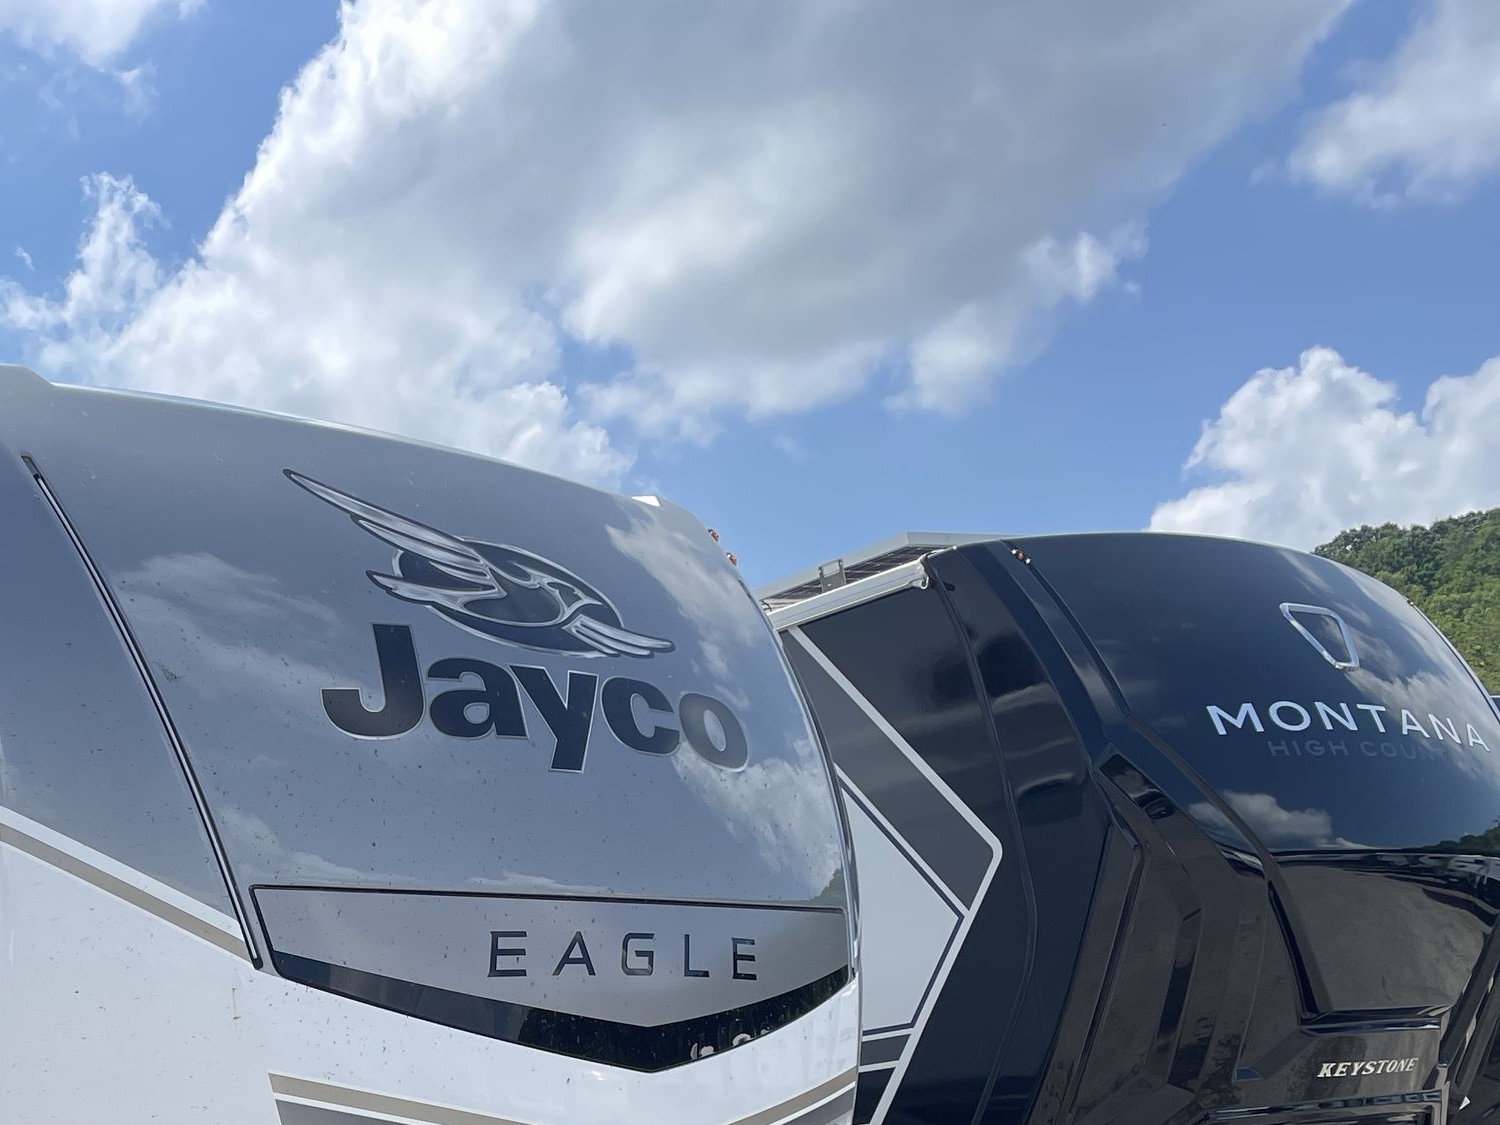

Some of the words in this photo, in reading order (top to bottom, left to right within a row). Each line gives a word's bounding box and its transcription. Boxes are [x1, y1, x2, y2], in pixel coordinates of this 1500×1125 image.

[319, 622, 749, 774] Jayco
[1206, 700, 1492, 752] MONTANA
[1267, 739, 1350, 758] HIGH
[486, 929, 759, 982] EAGLE
[1316, 1057, 1419, 1078] KEYSTONE
